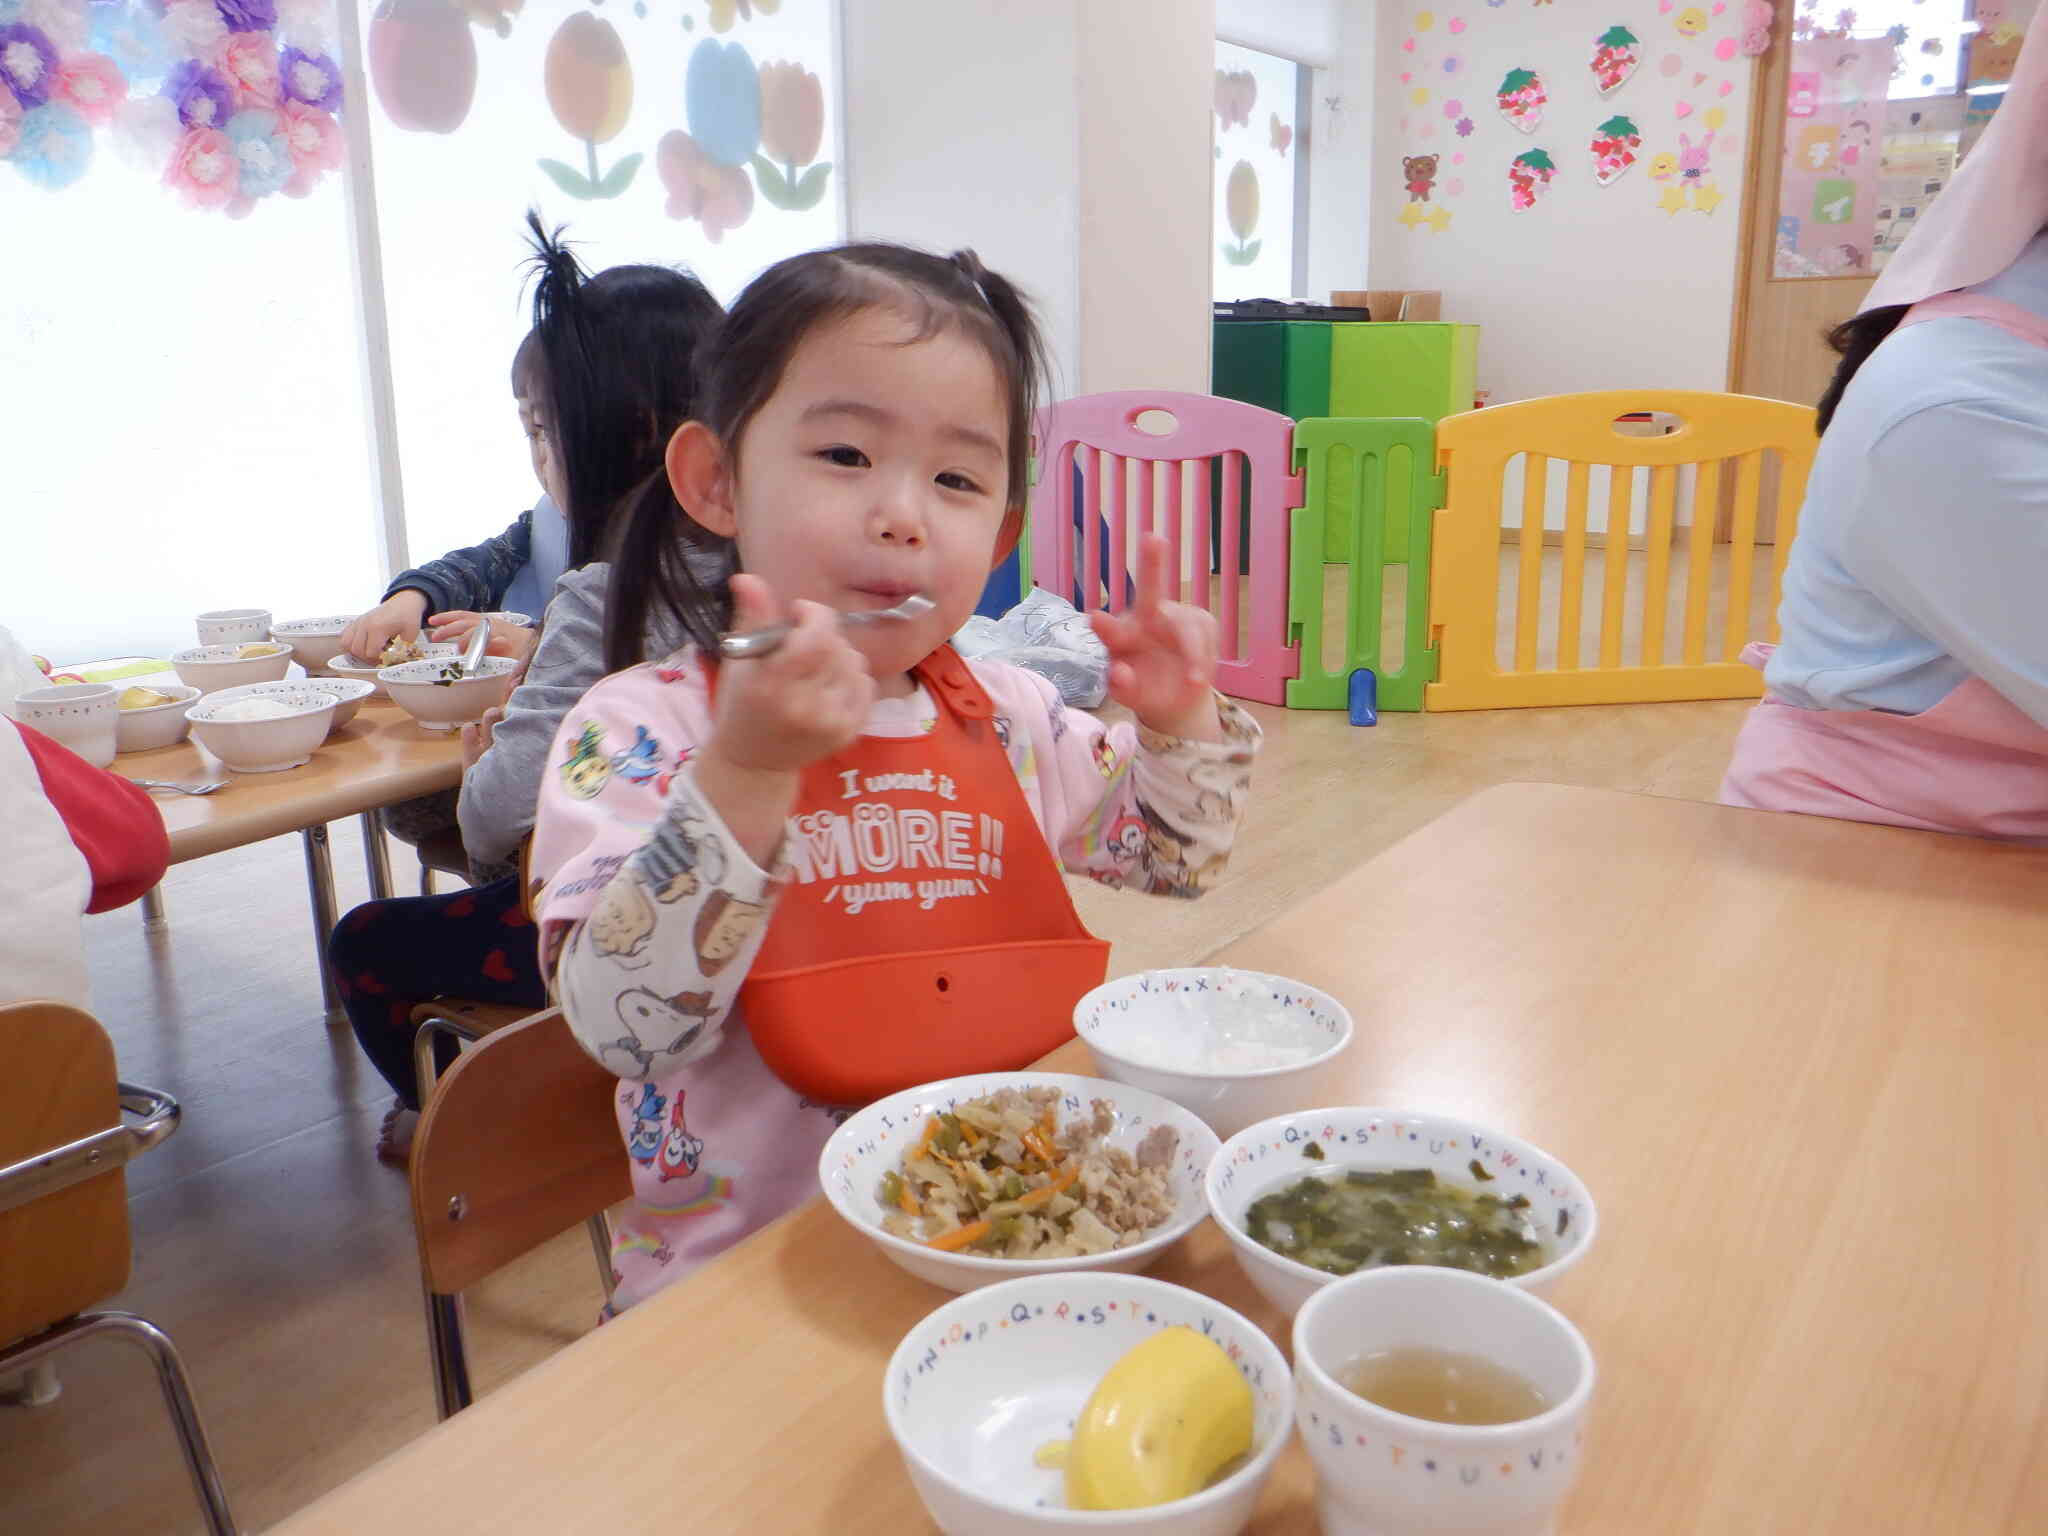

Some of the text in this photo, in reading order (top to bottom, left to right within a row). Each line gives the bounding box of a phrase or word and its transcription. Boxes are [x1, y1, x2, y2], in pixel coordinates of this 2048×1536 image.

[839, 768, 958, 800] I want it
[843, 879, 977, 914] yum yum
[1195, 978, 1208, 992] X
[1065, 1095, 1080, 1111] N
[1284, 1126, 1301, 1144] Q
[1355, 1128, 1369, 1144] S
[1471, 1133, 1483, 1149] V
[1011, 1302, 1032, 1323] Q
[1055, 1301, 1070, 1321] R
[1090, 1305, 1106, 1325] S
[1529, 1448, 1543, 1470] V
